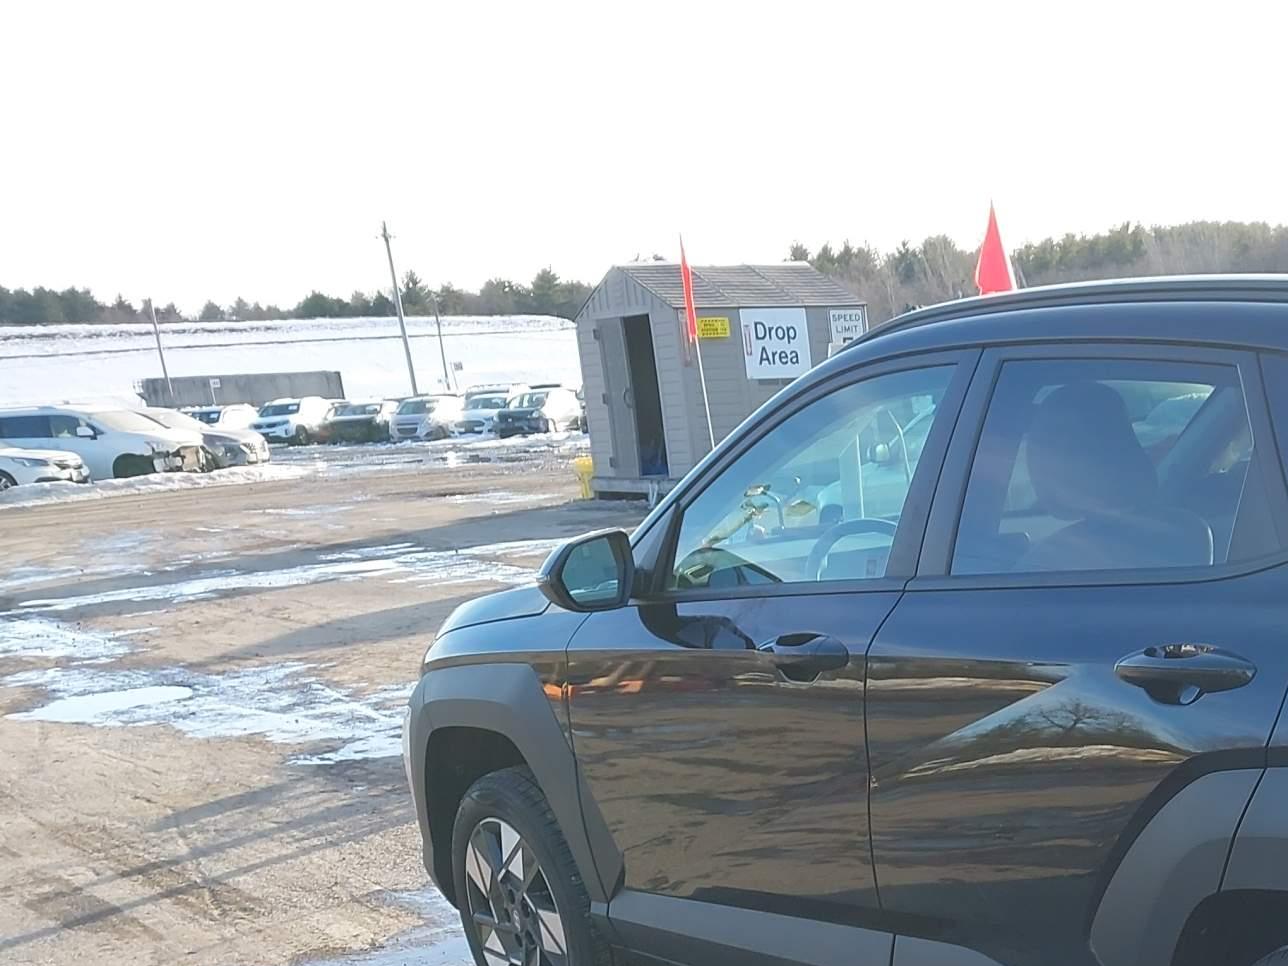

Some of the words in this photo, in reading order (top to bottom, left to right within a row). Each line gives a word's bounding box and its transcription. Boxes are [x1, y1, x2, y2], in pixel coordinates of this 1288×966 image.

[832, 313, 861, 322] SPEED
[753, 321, 798, 345] Drop
[835, 324, 859, 334] LIMIT
[758, 345, 800, 366] Area
